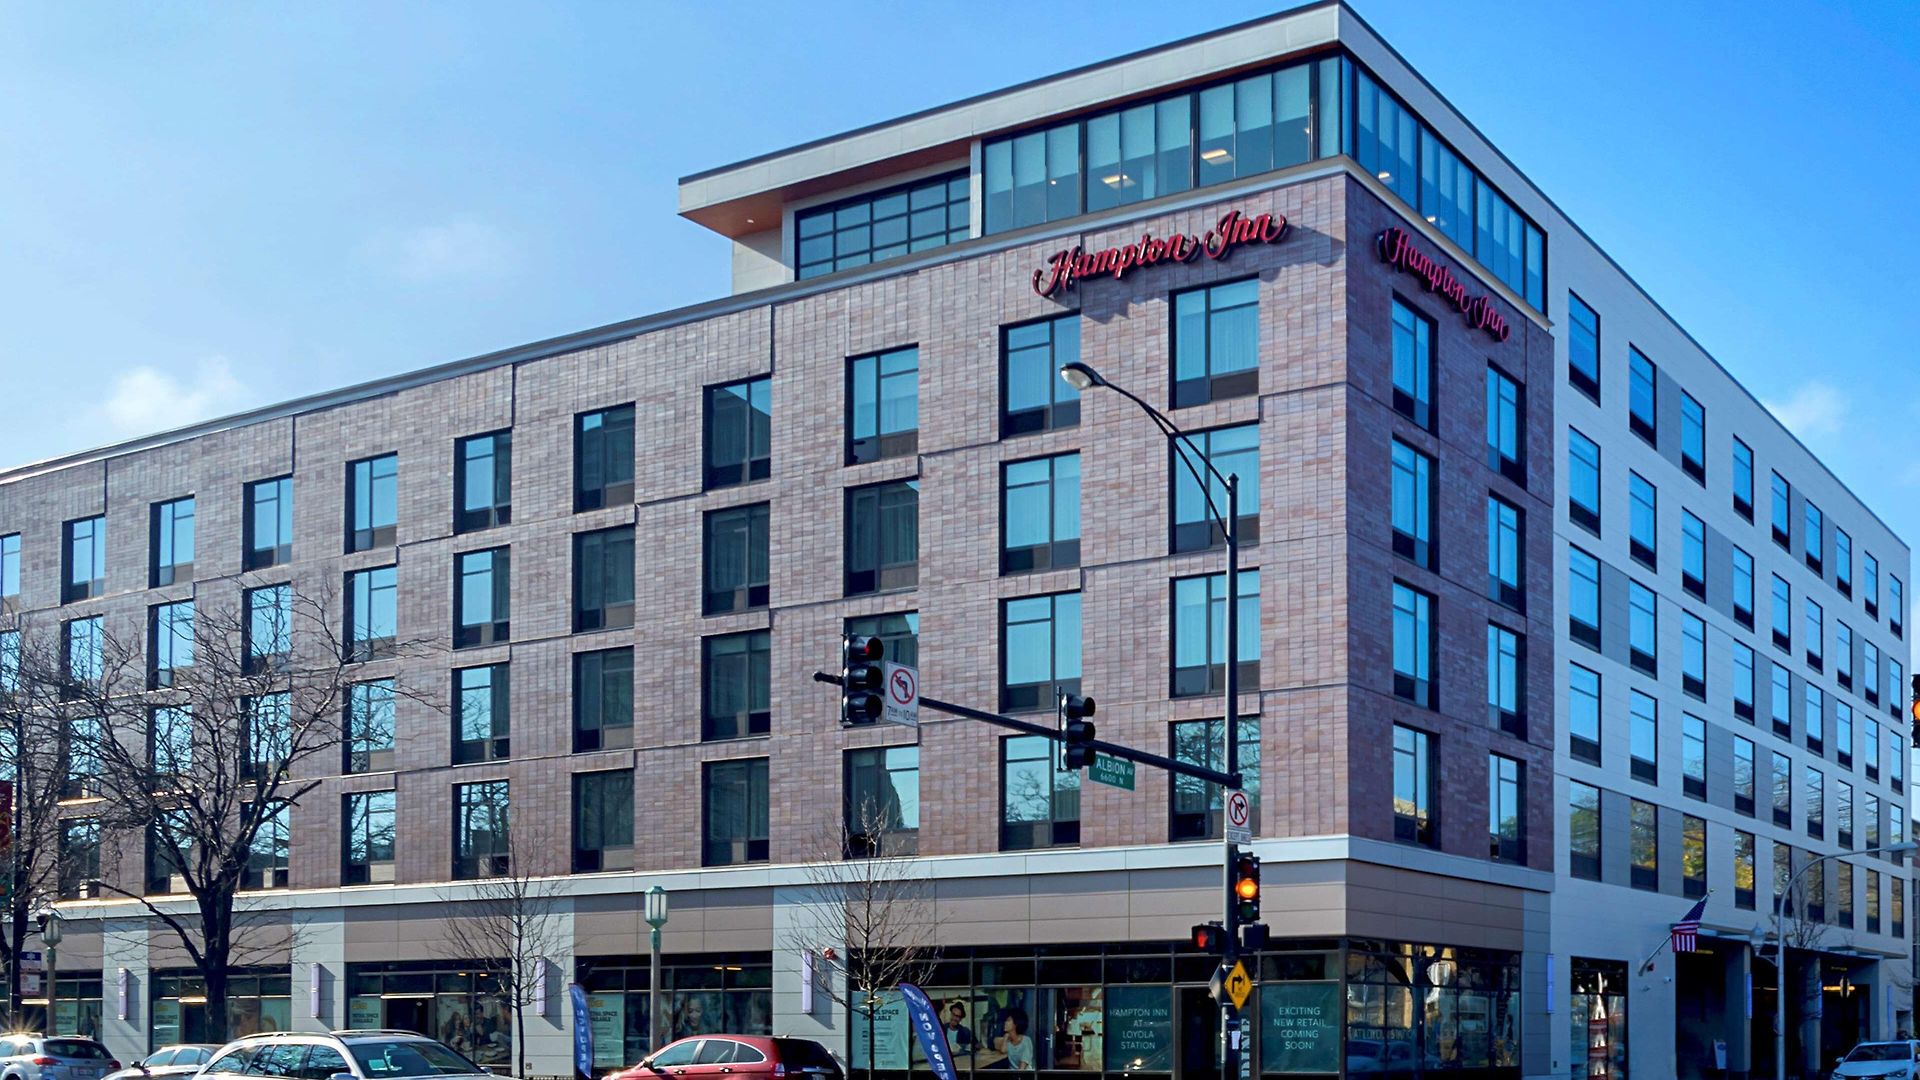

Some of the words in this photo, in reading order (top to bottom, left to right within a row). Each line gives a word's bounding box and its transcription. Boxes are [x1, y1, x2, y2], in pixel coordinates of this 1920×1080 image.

[1033, 233, 1199, 298] Hampton
[1203, 210, 1287, 260] Inn
[1379, 226, 1471, 313] Hampton
[1472, 295, 1510, 342] Inn
[1096, 758, 1126, 775] ALBION
[1119, 776, 1125, 785] N
[1109, 1008, 1151, 1017] HAMPTON
[1152, 1008, 1168, 1017] INN
[1279, 1006, 1321, 1016] EXCITING
[1133, 1019, 1143, 1028] AT
[1273, 1018, 1294, 1027] NEW
[1296, 1018, 1326, 1027] RETAIL
[1122, 1030, 1154, 1039] LOYOLA
[1280, 1029, 1319, 1039] COMING
[1120, 1041, 1156, 1050] STATION
[1284, 1041, 1315, 1050] SOON!
